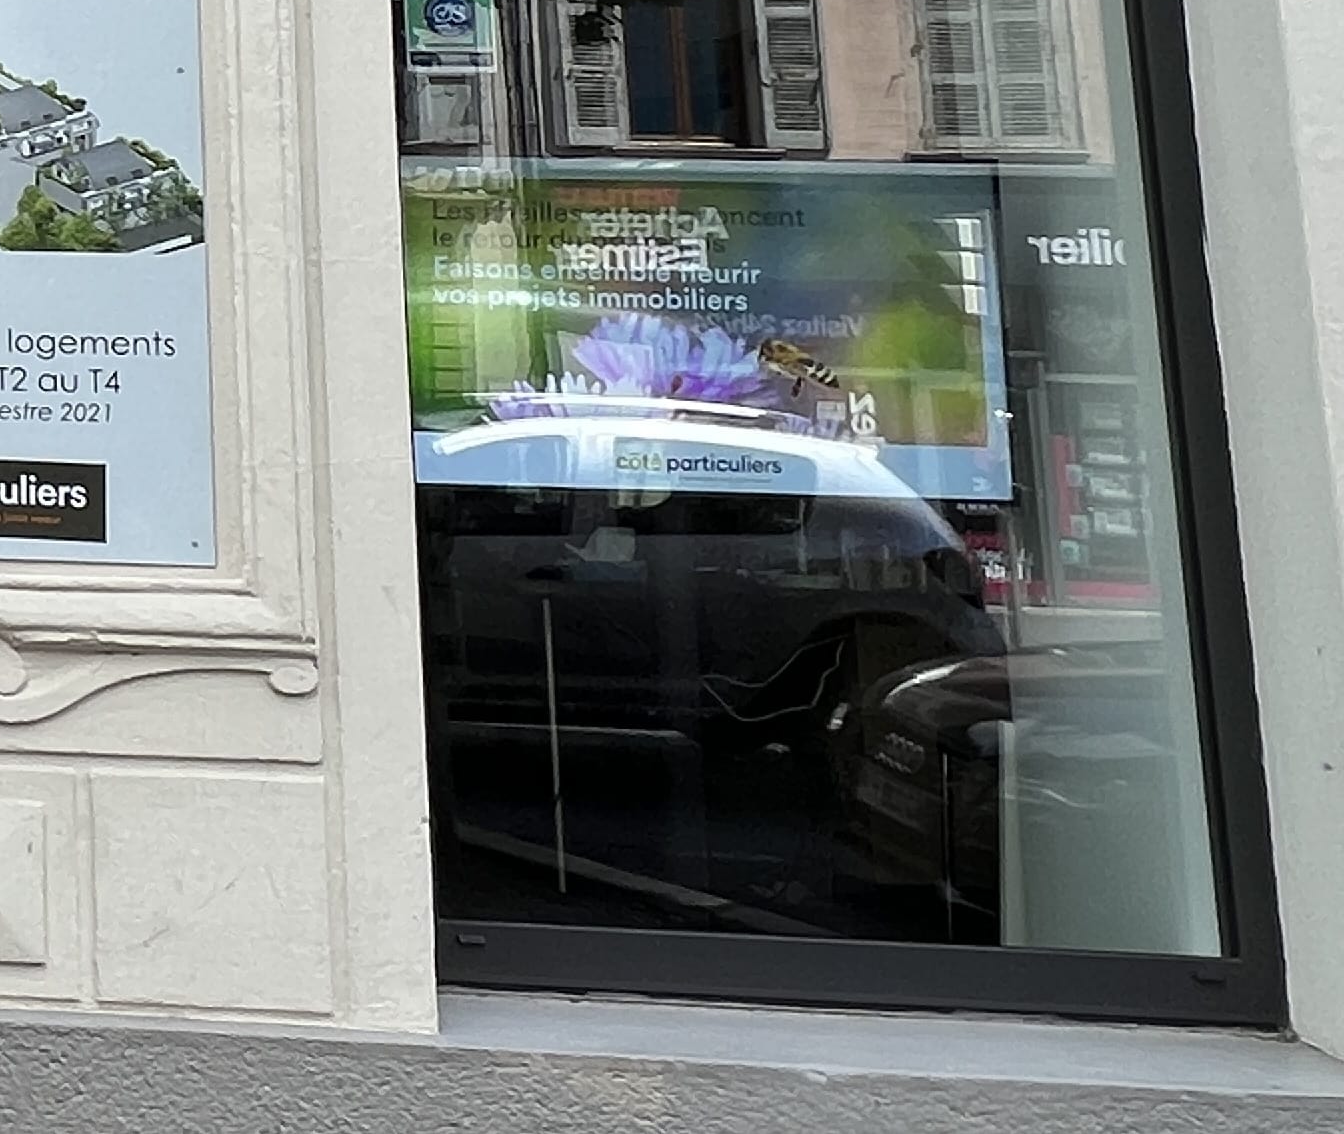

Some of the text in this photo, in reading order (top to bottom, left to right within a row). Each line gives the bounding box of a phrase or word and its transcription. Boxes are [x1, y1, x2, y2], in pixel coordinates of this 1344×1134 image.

[434, 255, 532, 281] Faisons
[433, 284, 748, 311] vos projets immobiliers
[8, 329, 175, 359] logements
[39, 373, 77, 393] au
[89, 369, 119, 393] T4
[61, 403, 110, 422] 2021
[666, 453, 782, 475] particuliers
